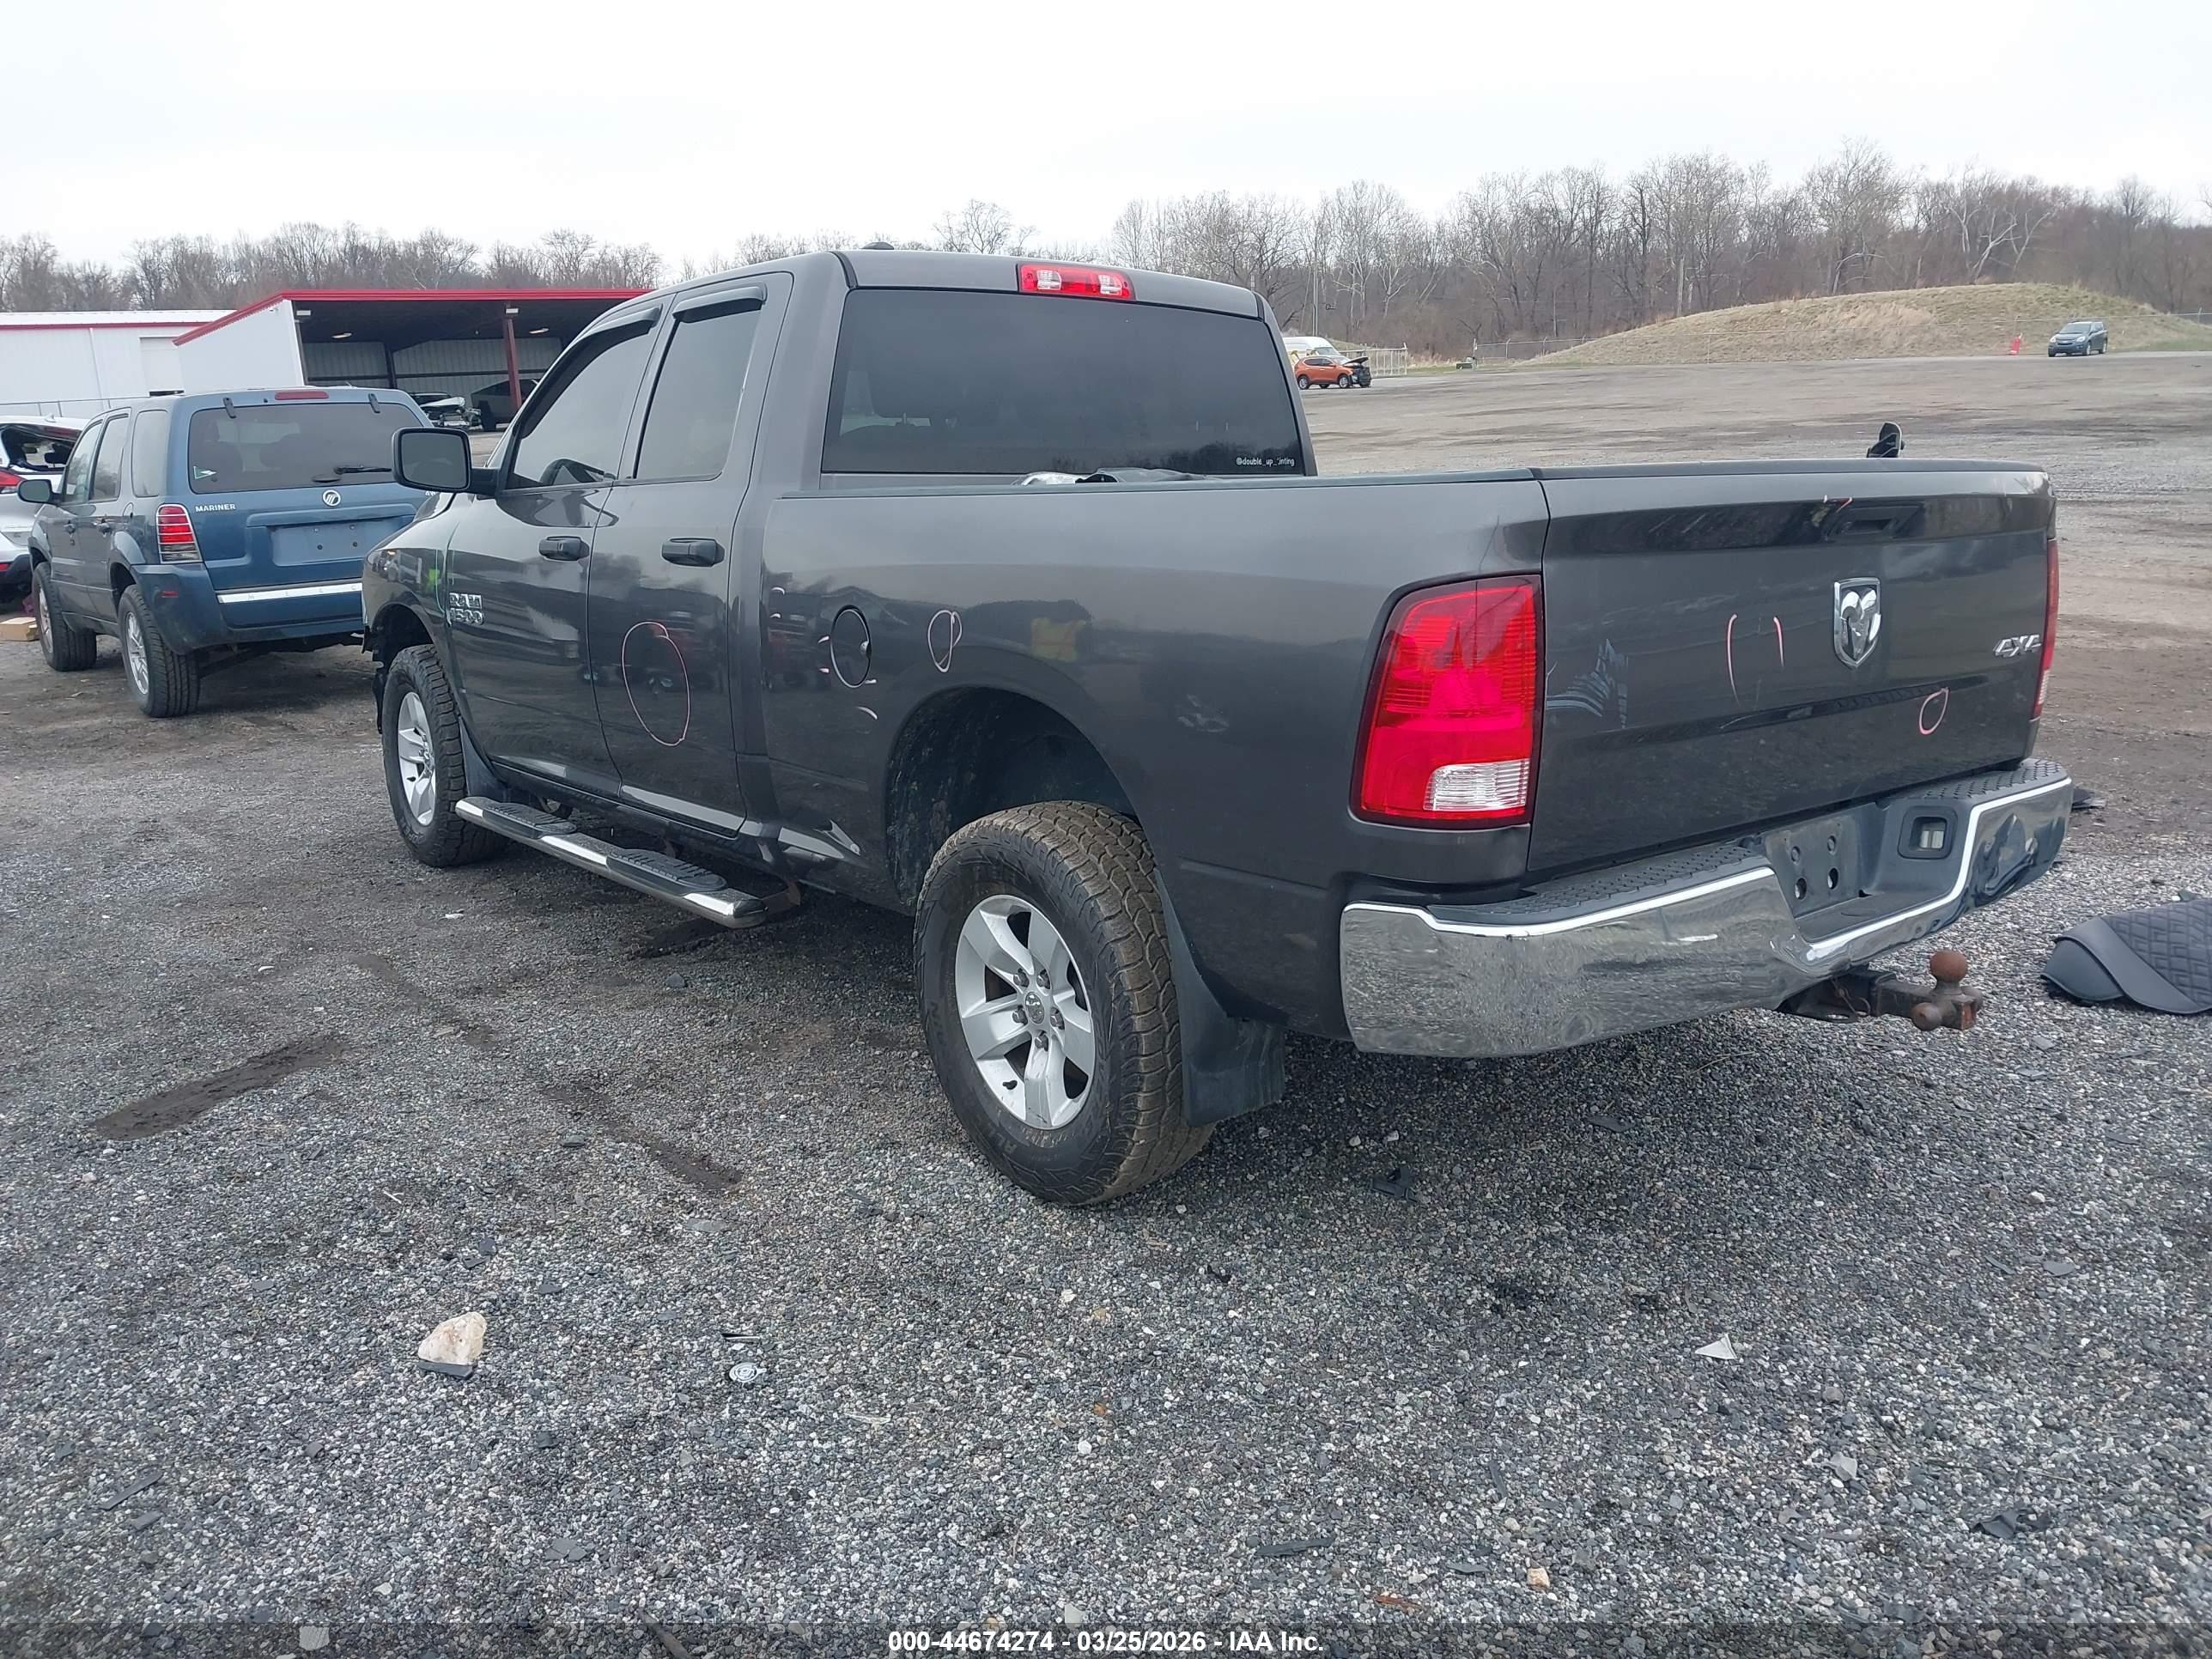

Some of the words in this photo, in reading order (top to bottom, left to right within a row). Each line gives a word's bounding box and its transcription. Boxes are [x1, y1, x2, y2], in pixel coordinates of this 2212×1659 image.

[196, 502, 236, 514] MARINER
[449, 592, 483, 608] RAM
[450, 607, 484, 625] 1500
